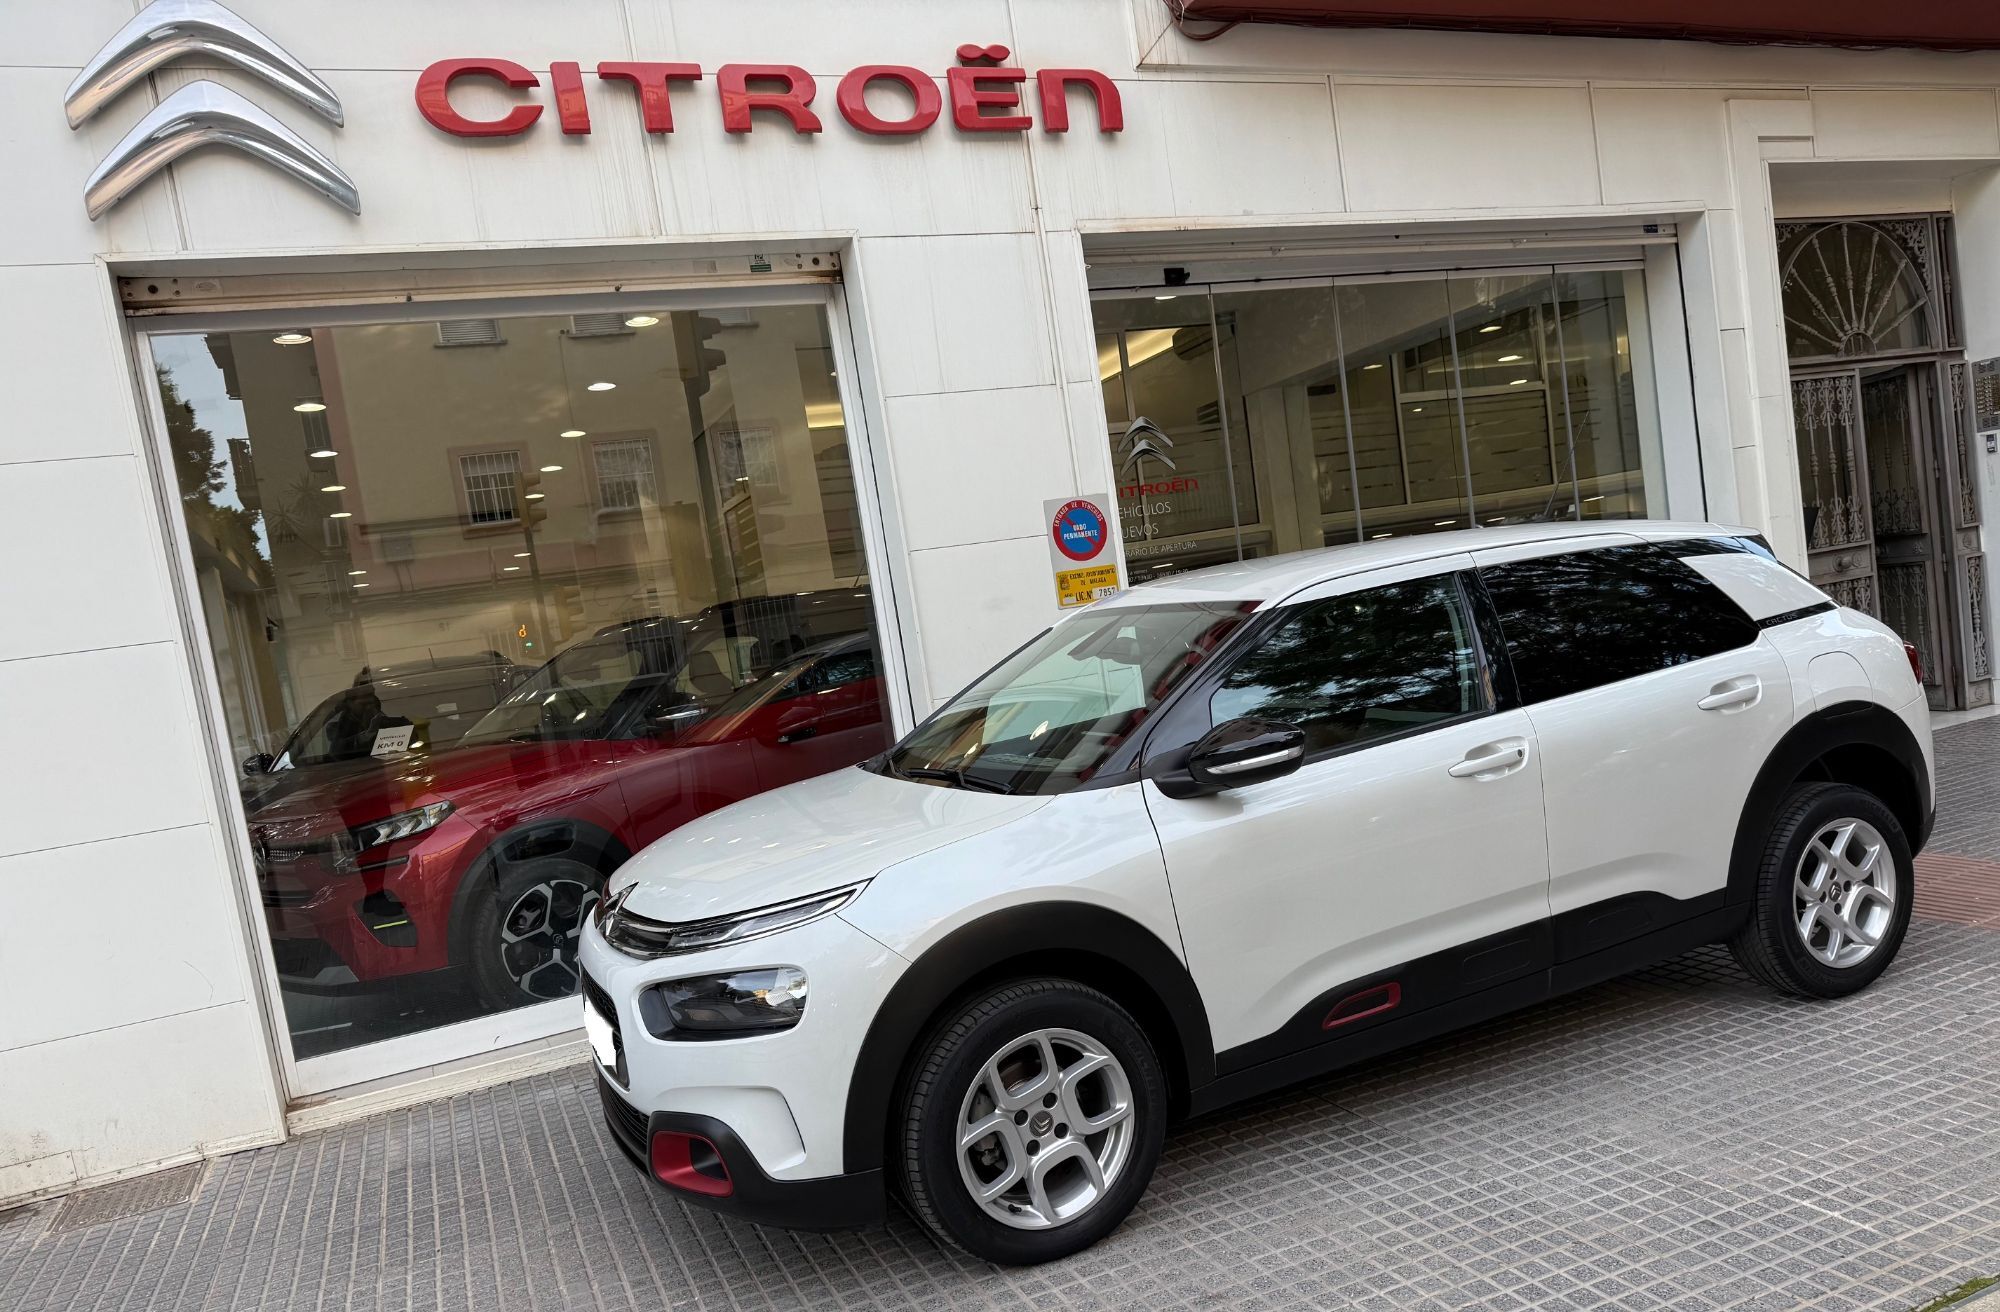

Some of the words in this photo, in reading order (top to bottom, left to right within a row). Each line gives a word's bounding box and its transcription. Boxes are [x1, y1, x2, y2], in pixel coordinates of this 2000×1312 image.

[415, 44, 1123, 138] CITROËN
[1119, 477, 1199, 498] ITROËN
[1053, 506, 1069, 527] ENTRADA
[1118, 501, 1171, 519] EHÍCULOS
[1063, 530, 1098, 540] PERMANENTE
[1121, 522, 1159, 539] UEVOS
[1125, 548, 1148, 558] RARIO
[1149, 545, 1160, 554] DE
[1161, 540, 1197, 553] APERTURA
[1766, 613, 1798, 626] CACTUS
